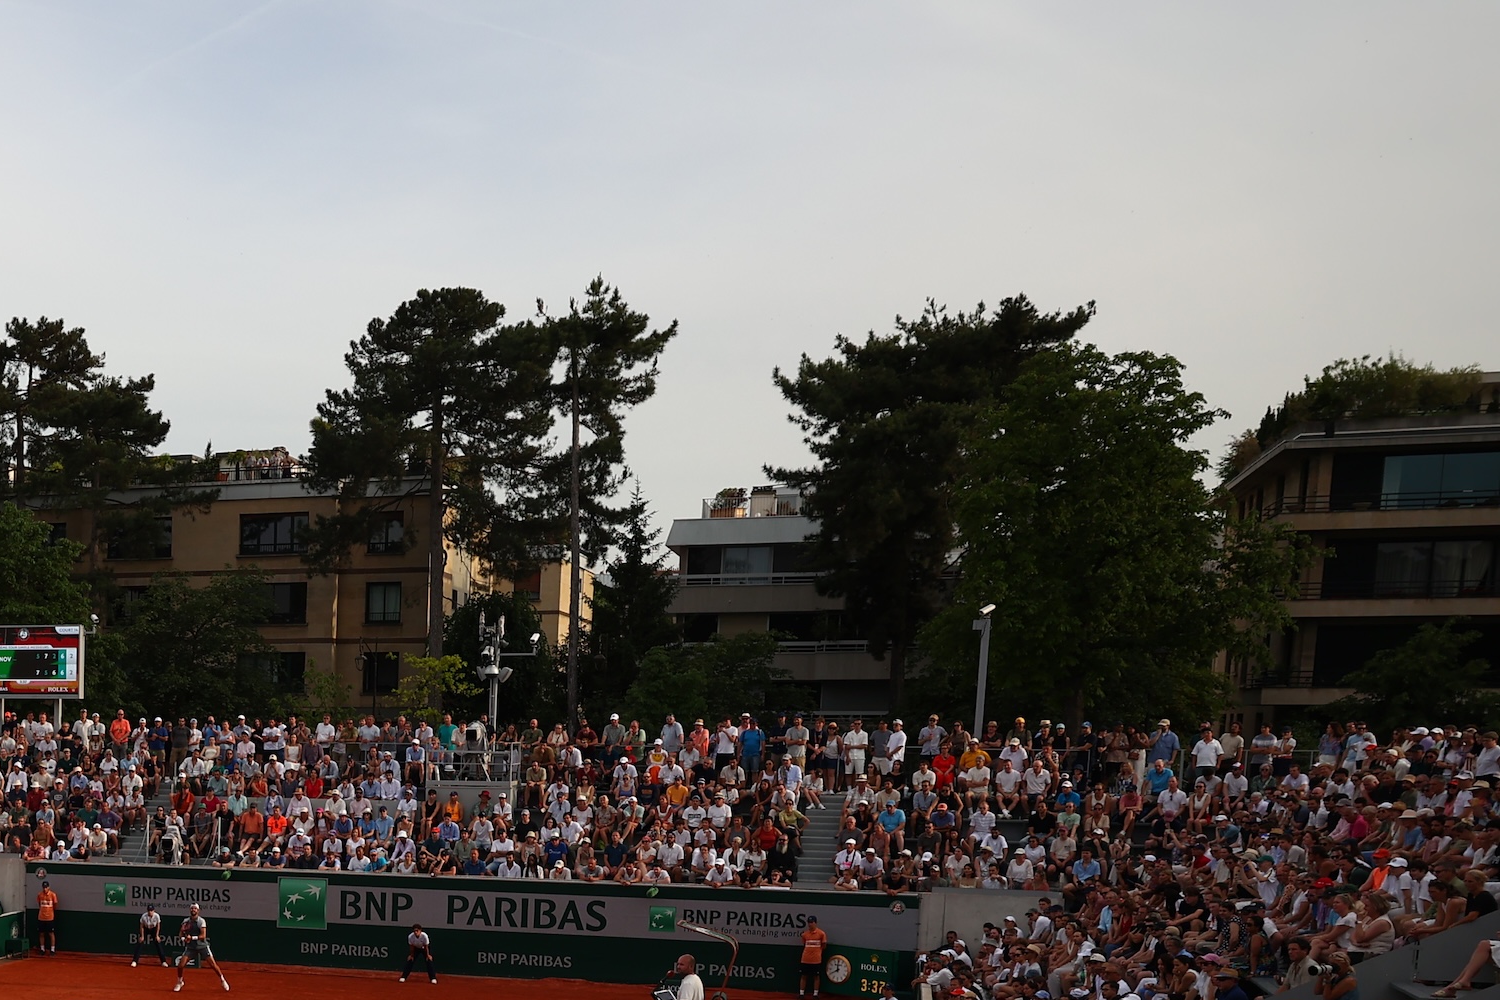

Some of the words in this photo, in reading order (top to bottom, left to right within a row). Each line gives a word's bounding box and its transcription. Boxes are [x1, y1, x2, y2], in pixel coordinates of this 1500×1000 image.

[132, 886, 162, 900] BNP
[167, 887, 231, 903] PARIBAS
[340, 890, 414, 922] BNP
[447, 895, 607, 931] PARIBAS
[683, 909, 721, 924] BNP
[727, 911, 806, 928] PARIBAS
[129, 933, 154, 945] BP
[742, 928, 779, 938] changing
[300, 942, 328, 955] BNP
[332, 944, 388, 958] PARIBAS
[477, 951, 507, 965] BNP
[511, 953, 572, 968] PARIBAS
[709, 964, 776, 979] PARIBAS
[860, 963, 888, 973] ROLEX
[860, 977, 886, 994] 3:37
